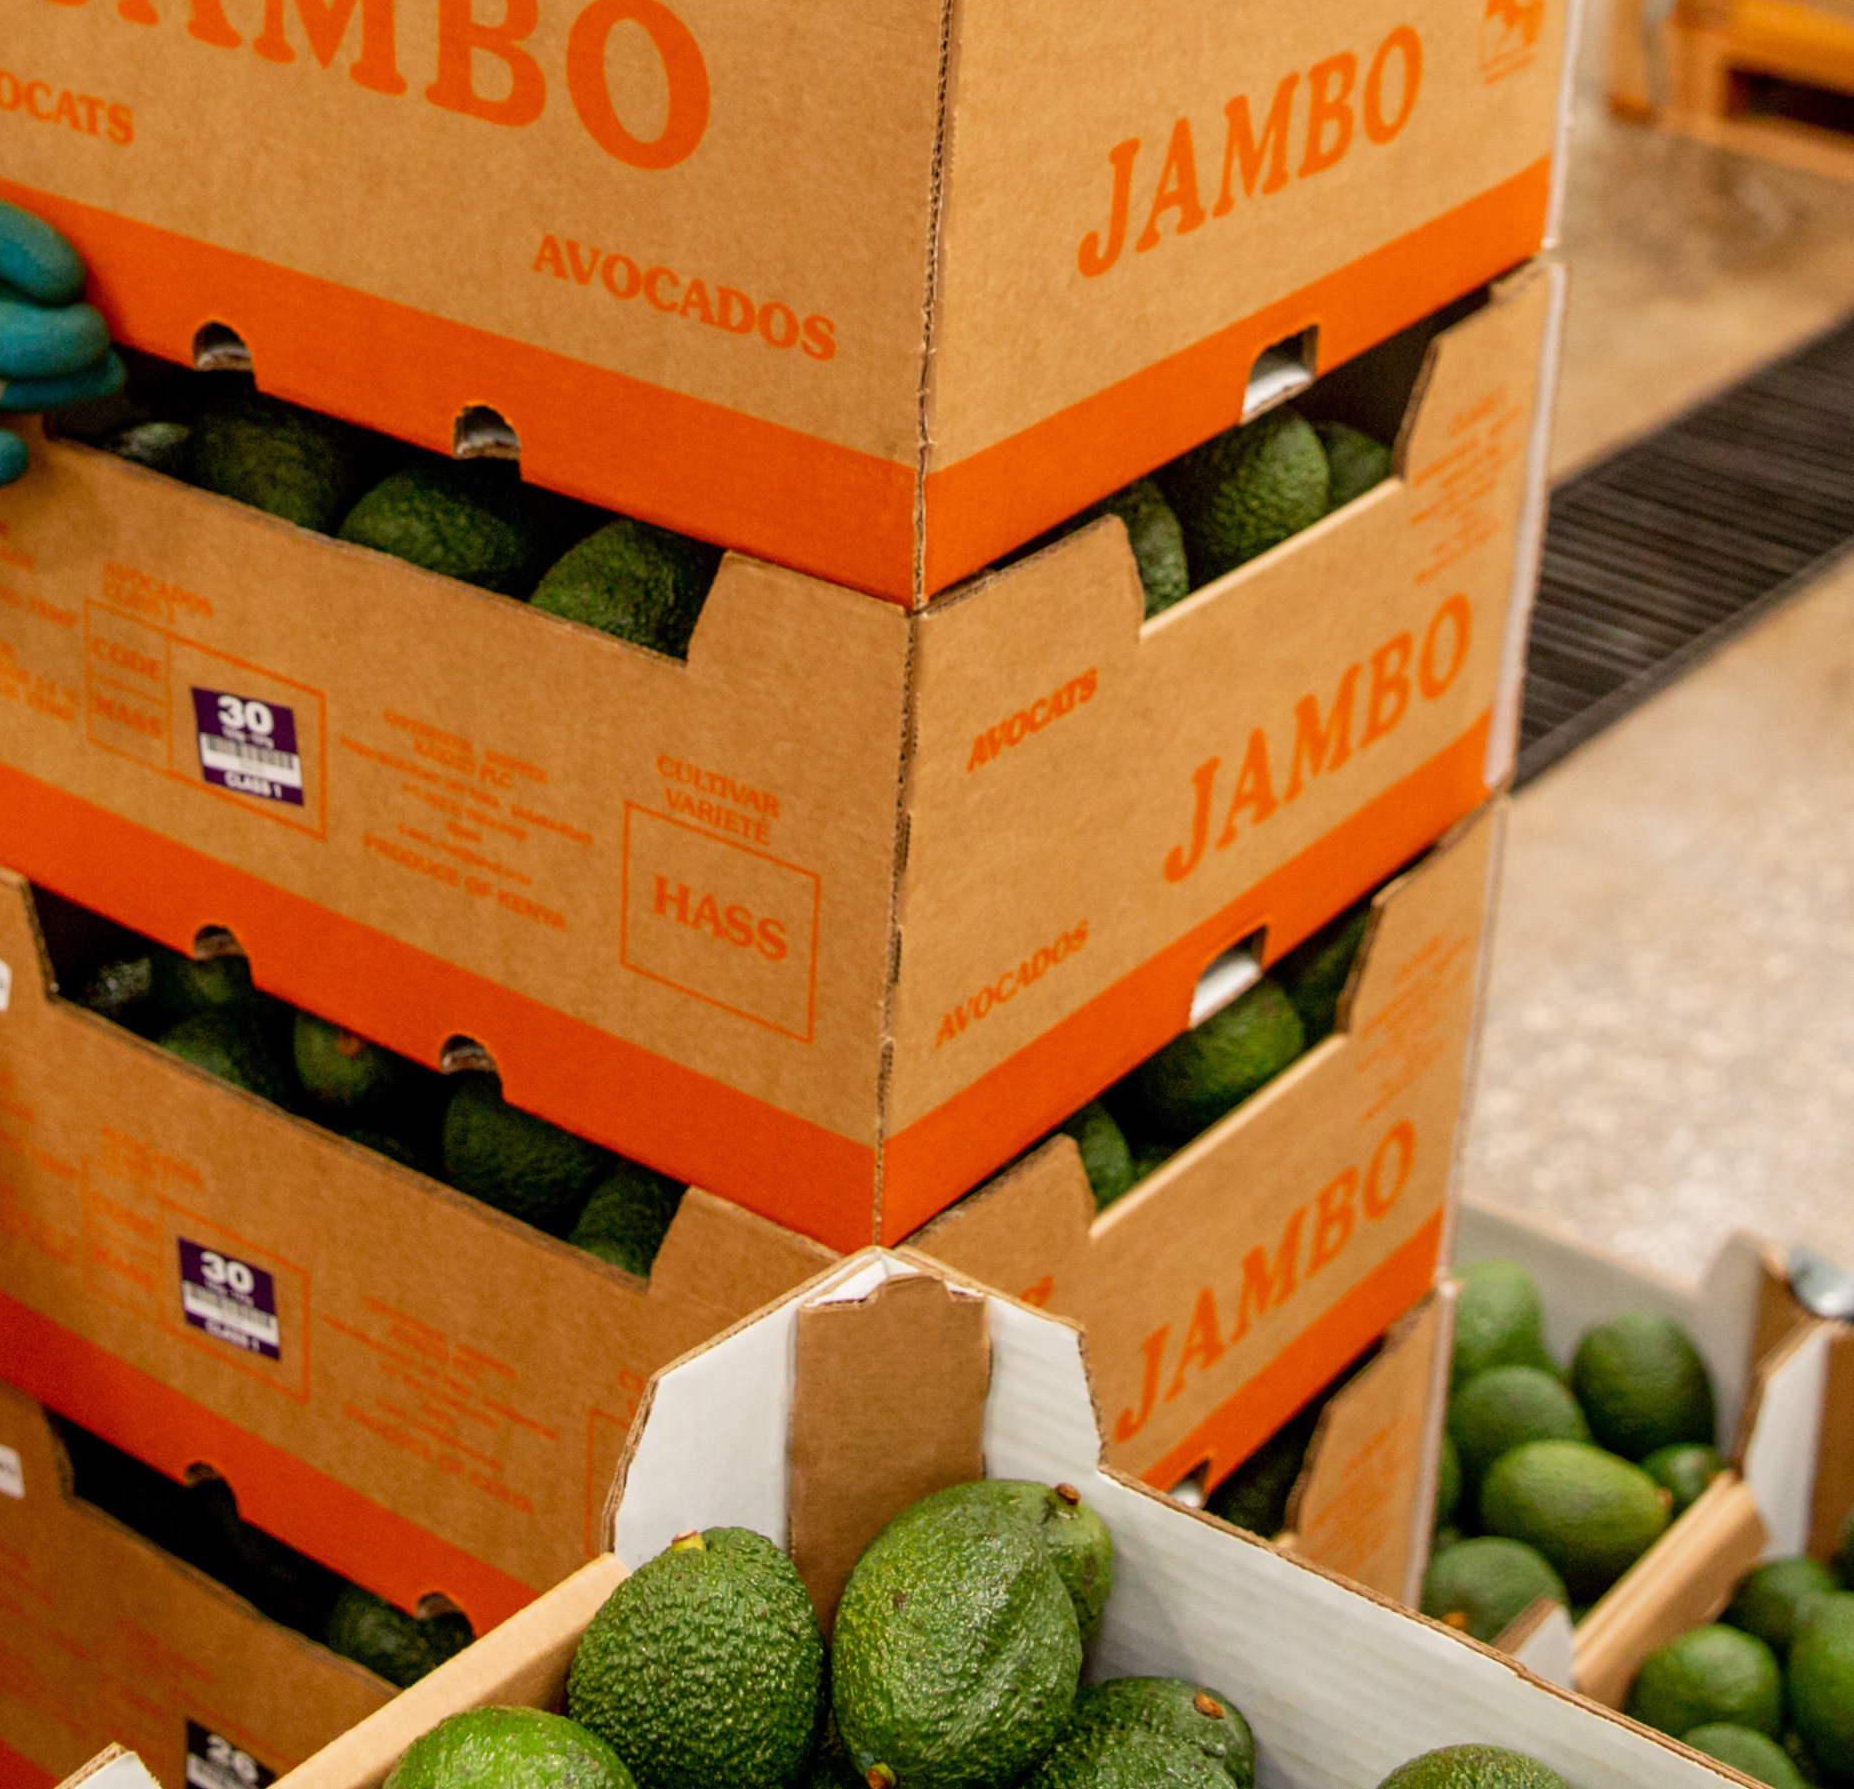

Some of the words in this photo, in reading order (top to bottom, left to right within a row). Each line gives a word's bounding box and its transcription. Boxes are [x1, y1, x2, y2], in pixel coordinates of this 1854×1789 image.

[1078, 25, 1423, 278] JAMBO
[532, 234, 836, 362] AVOCADOS
[217, 695, 274, 736] 30
[967, 667, 1098, 773] AVOCATS
[1164, 593, 1472, 884] JAMBO
[657, 755, 780, 818] CULTIVAR
[653, 875, 788, 961] HASS
[935, 919, 1090, 1050] AVOCADOS
[200, 1251, 255, 1294] 30
[1113, 1119, 1417, 1444] JAMBO
[207, 1733, 259, 1787] 30
